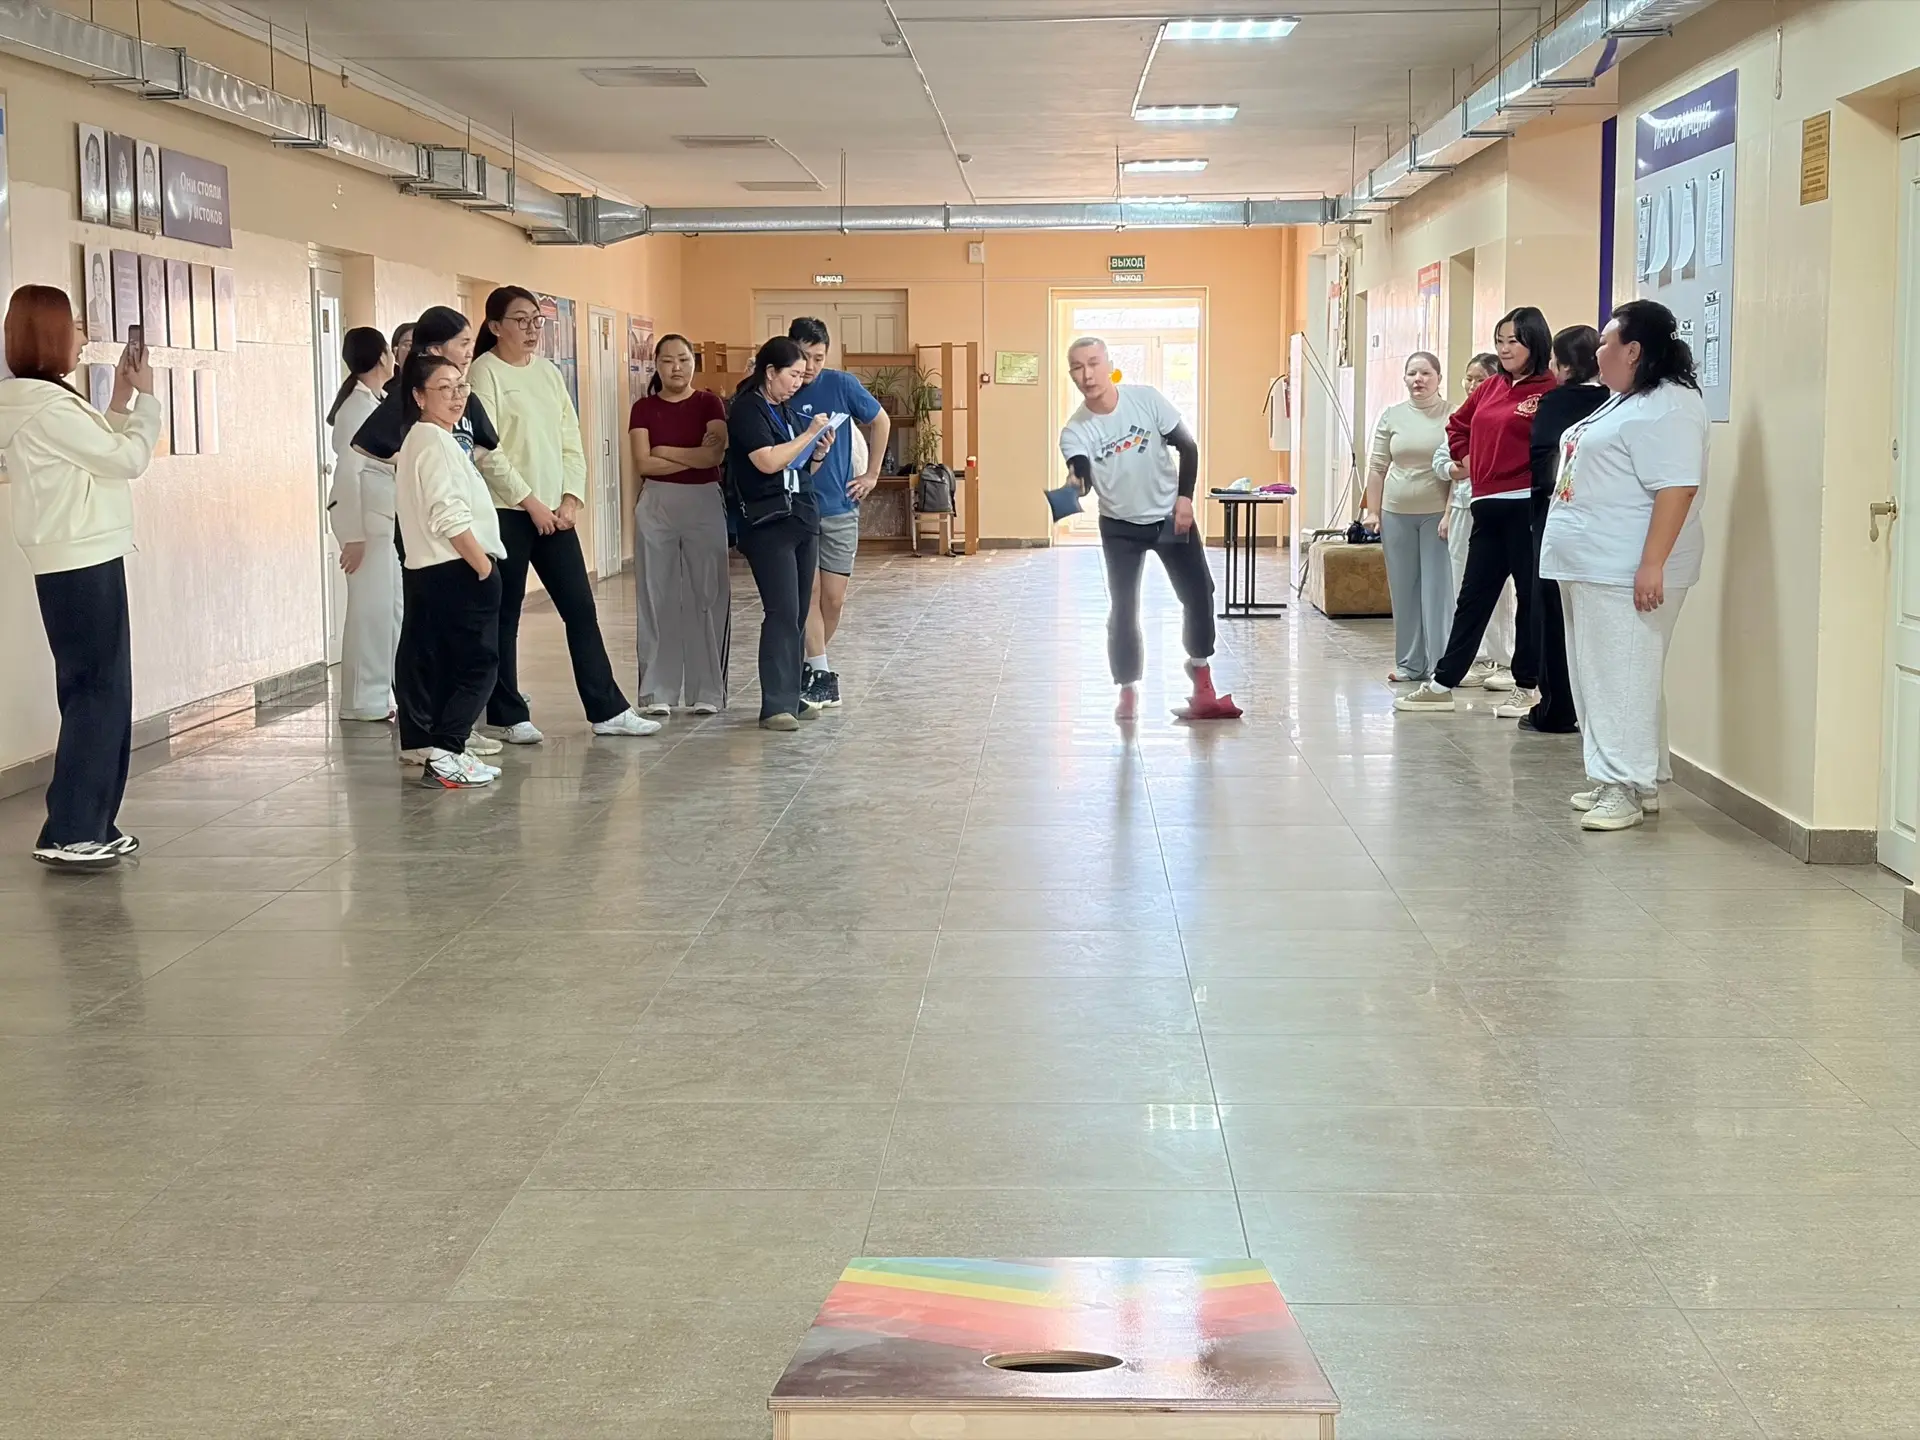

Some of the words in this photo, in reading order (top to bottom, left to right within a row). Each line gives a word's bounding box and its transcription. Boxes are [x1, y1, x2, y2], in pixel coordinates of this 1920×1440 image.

[180, 171, 196, 193] Они
[197, 180, 222, 201] стояли
[193, 203, 222, 225] истоков
[1111, 257, 1144, 268] ВЫХОД
[815, 275, 843, 283] ВЫХОД
[1115, 274, 1142, 282] ВЫХОД
